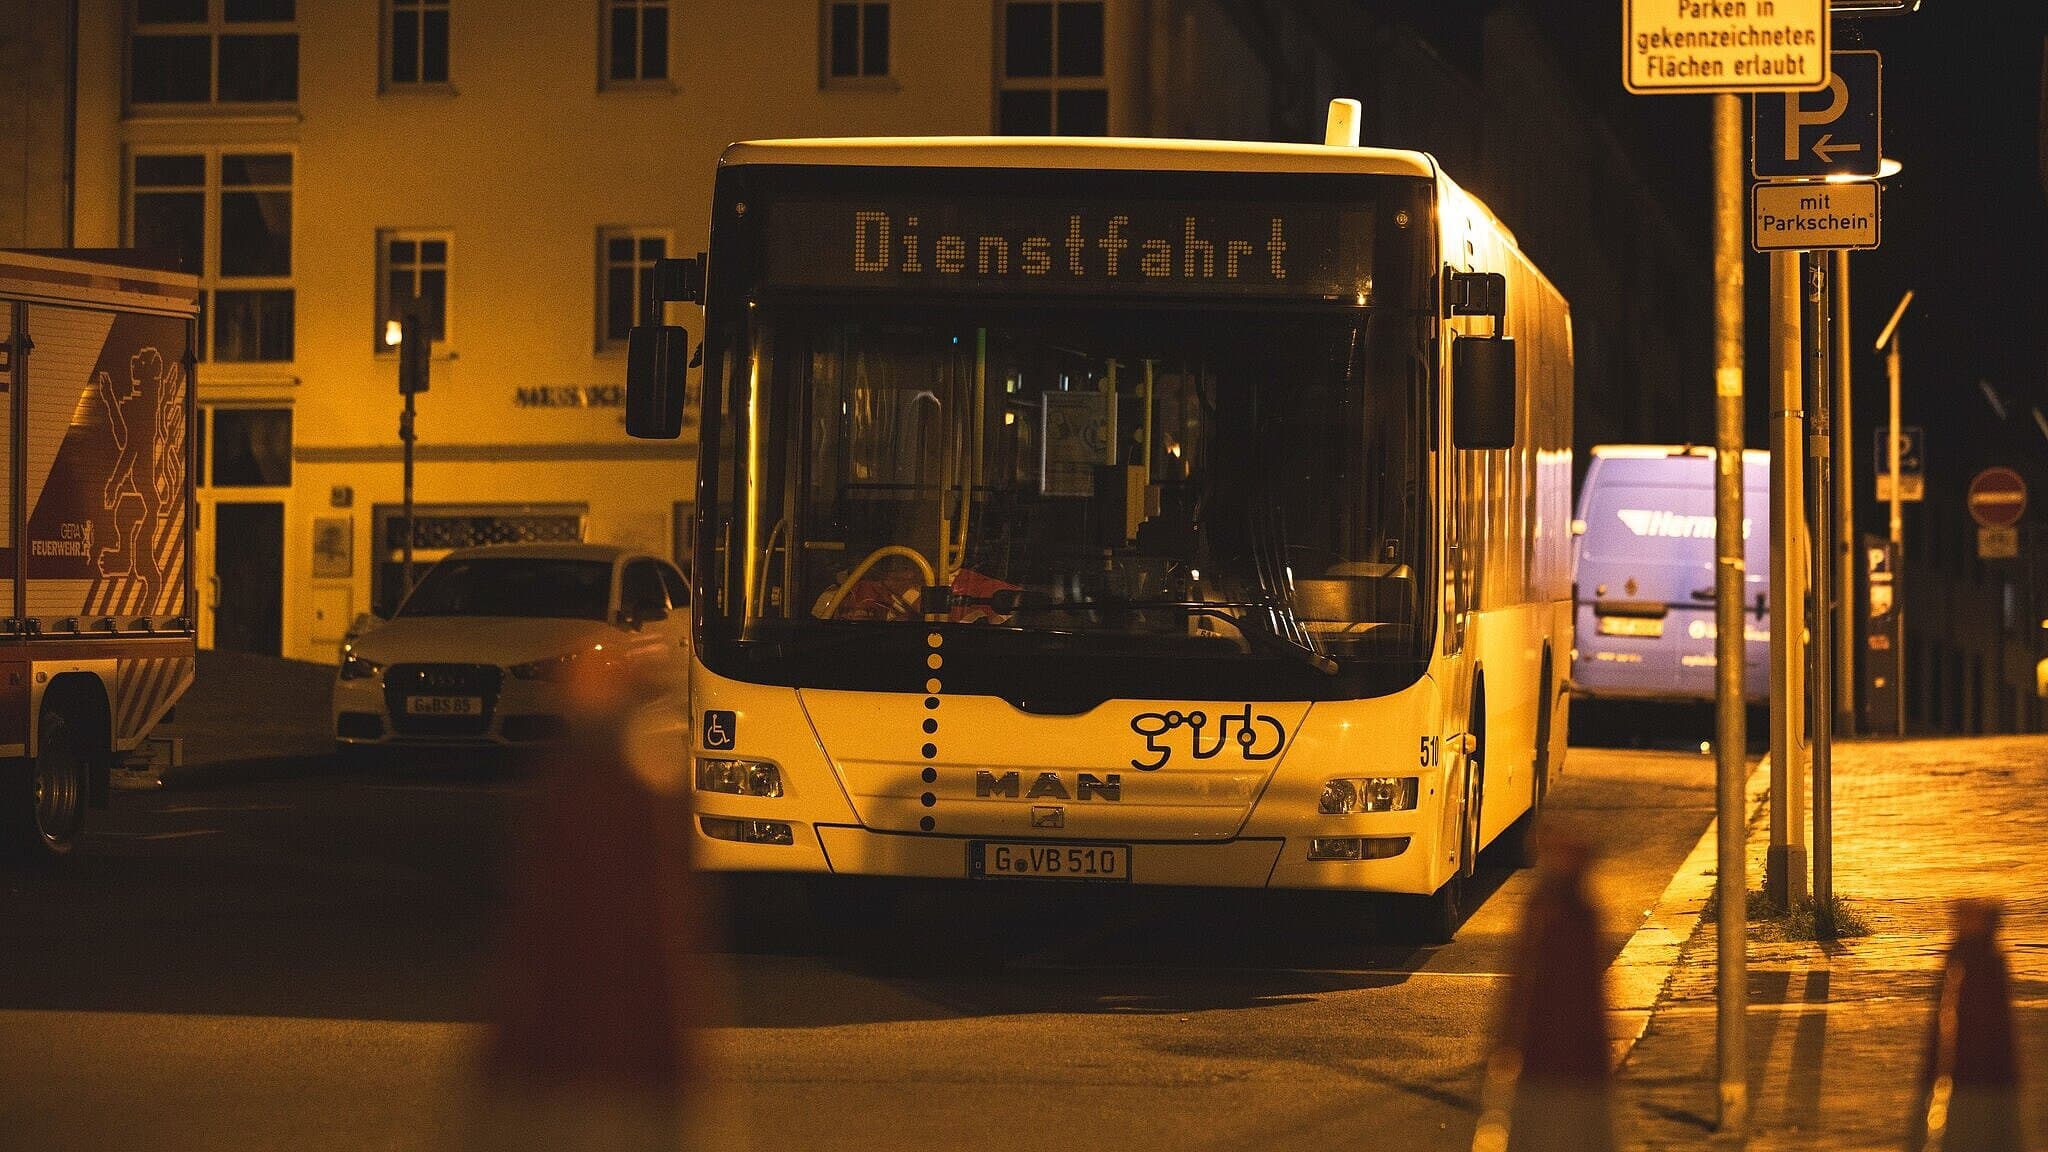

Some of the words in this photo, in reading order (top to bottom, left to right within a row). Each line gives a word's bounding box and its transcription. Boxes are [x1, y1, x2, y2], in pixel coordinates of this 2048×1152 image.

[1678, 0, 1746, 19] Parken
[1756, 0, 1775, 17] in
[1637, 25, 1815, 55] gekennzeichneten
[1647, 55, 1724, 78] Flächen
[1734, 54, 1805, 77] erlaubt
[1784, 71, 1849, 161] P
[1800, 194, 1831, 210] mit
[1763, 213, 1869, 231] Parkschein
[853, 210, 1289, 280] Dienstfahrt
[61, 523, 81, 539] GERA
[31, 540, 81, 557] FEUERWEHR
[1420, 736, 1440, 768] 510
[975, 770, 1121, 801] MAN
[1068, 849, 1115, 874] 510
